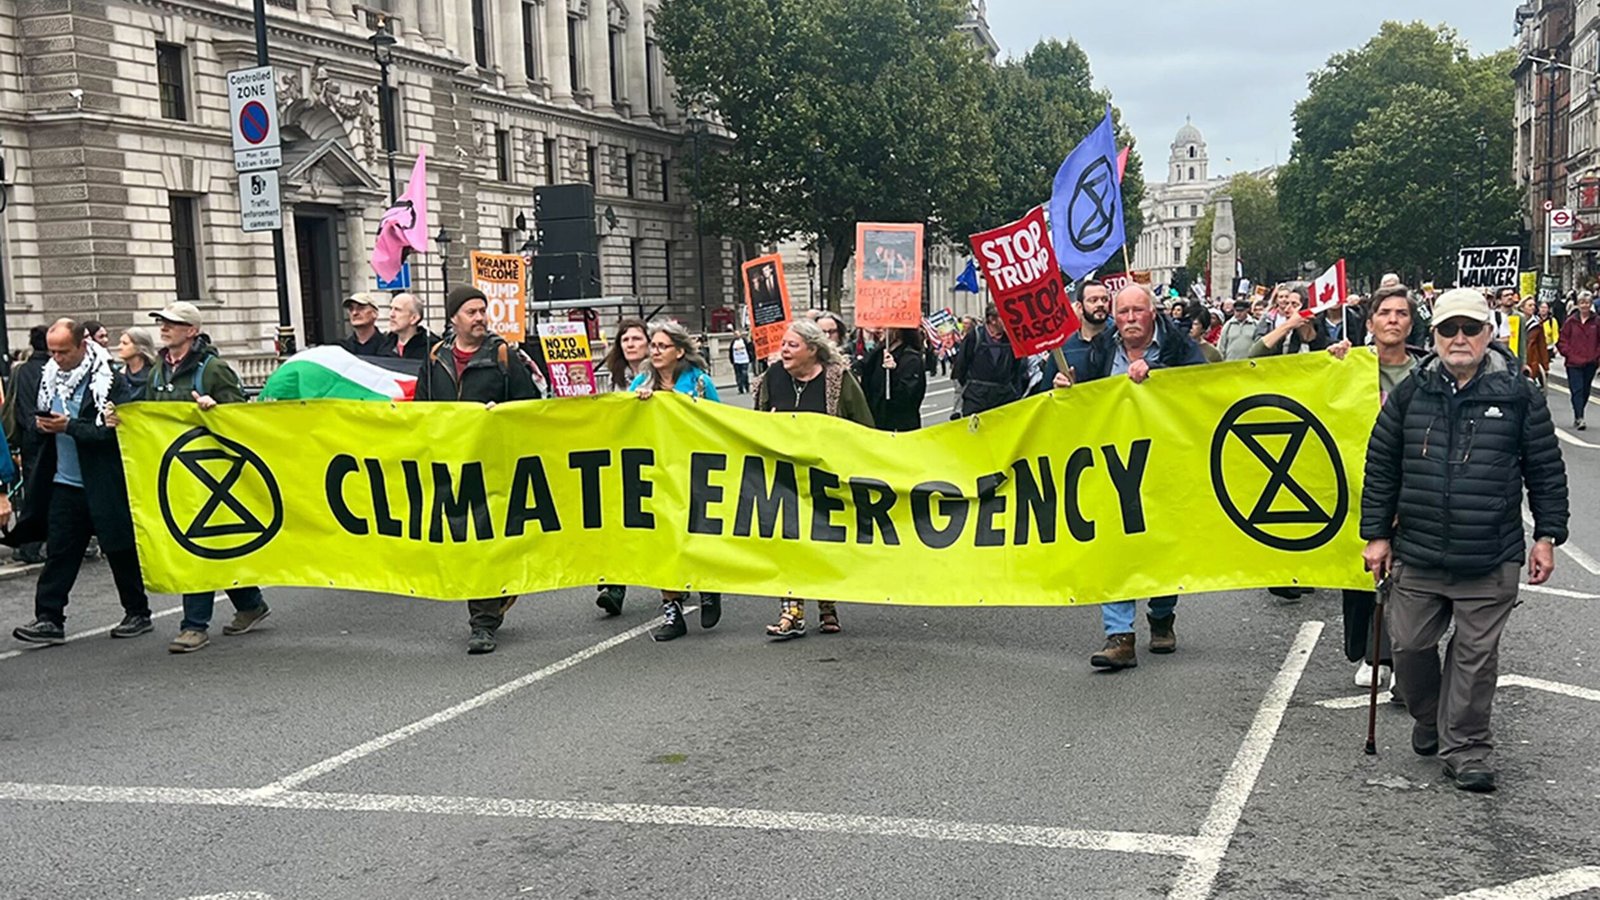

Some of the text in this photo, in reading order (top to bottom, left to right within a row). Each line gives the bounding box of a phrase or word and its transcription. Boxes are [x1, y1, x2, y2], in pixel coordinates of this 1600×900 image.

[230, 71, 271, 85] Controlled
[237, 84, 266, 99] ZONE
[251, 199, 270, 207] Traffic
[244, 209, 279, 218] enforcement
[981, 220, 1042, 270] STOP
[475, 256, 519, 269] MIGRANTS
[1508, 248, 1518, 267] A
[477, 267, 519, 280] WELCOME
[989, 247, 1049, 291] TRUMP
[1104, 276, 1127, 291] STO
[1459, 268, 1516, 288] WANKER
[1003, 278, 1059, 326] STOP
[488, 298, 520, 323] OT
[487, 322, 520, 334] LCOME
[545, 337, 577, 349] NO TO
[547, 348, 587, 360] RACISM
[550, 363, 567, 376] NO
[554, 374, 569, 386] TO
[556, 384, 593, 397] TRUMP
[325, 438, 1152, 549] CLIMATE EMERGENCY
